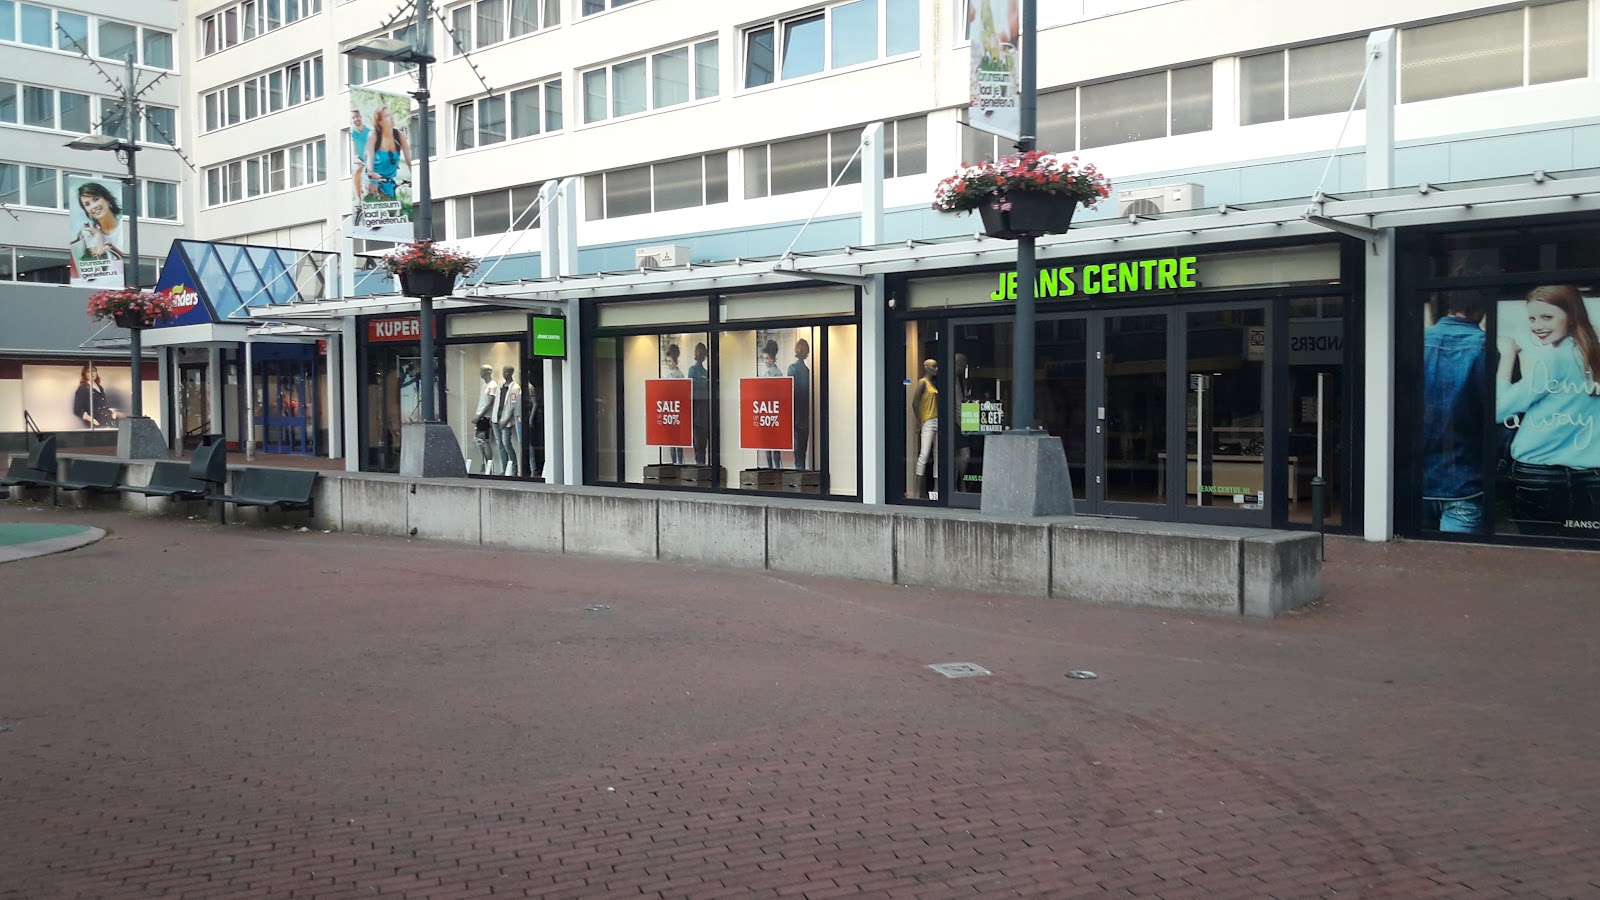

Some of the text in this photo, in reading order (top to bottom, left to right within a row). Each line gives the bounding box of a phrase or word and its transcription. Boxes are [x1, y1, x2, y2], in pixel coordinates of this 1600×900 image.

[364, 210, 388, 218] laat je
[365, 216, 407, 228] genieten.nl
[1083, 256, 1197, 295] CENTRE
[376, 320, 420, 337] KUPER
[656, 400, 681, 413] SALE
[752, 400, 780, 414] SALE
[662, 414, 681, 425] 50%
[759, 415, 780, 427] 50%
[988, 411, 1002, 425] GET
